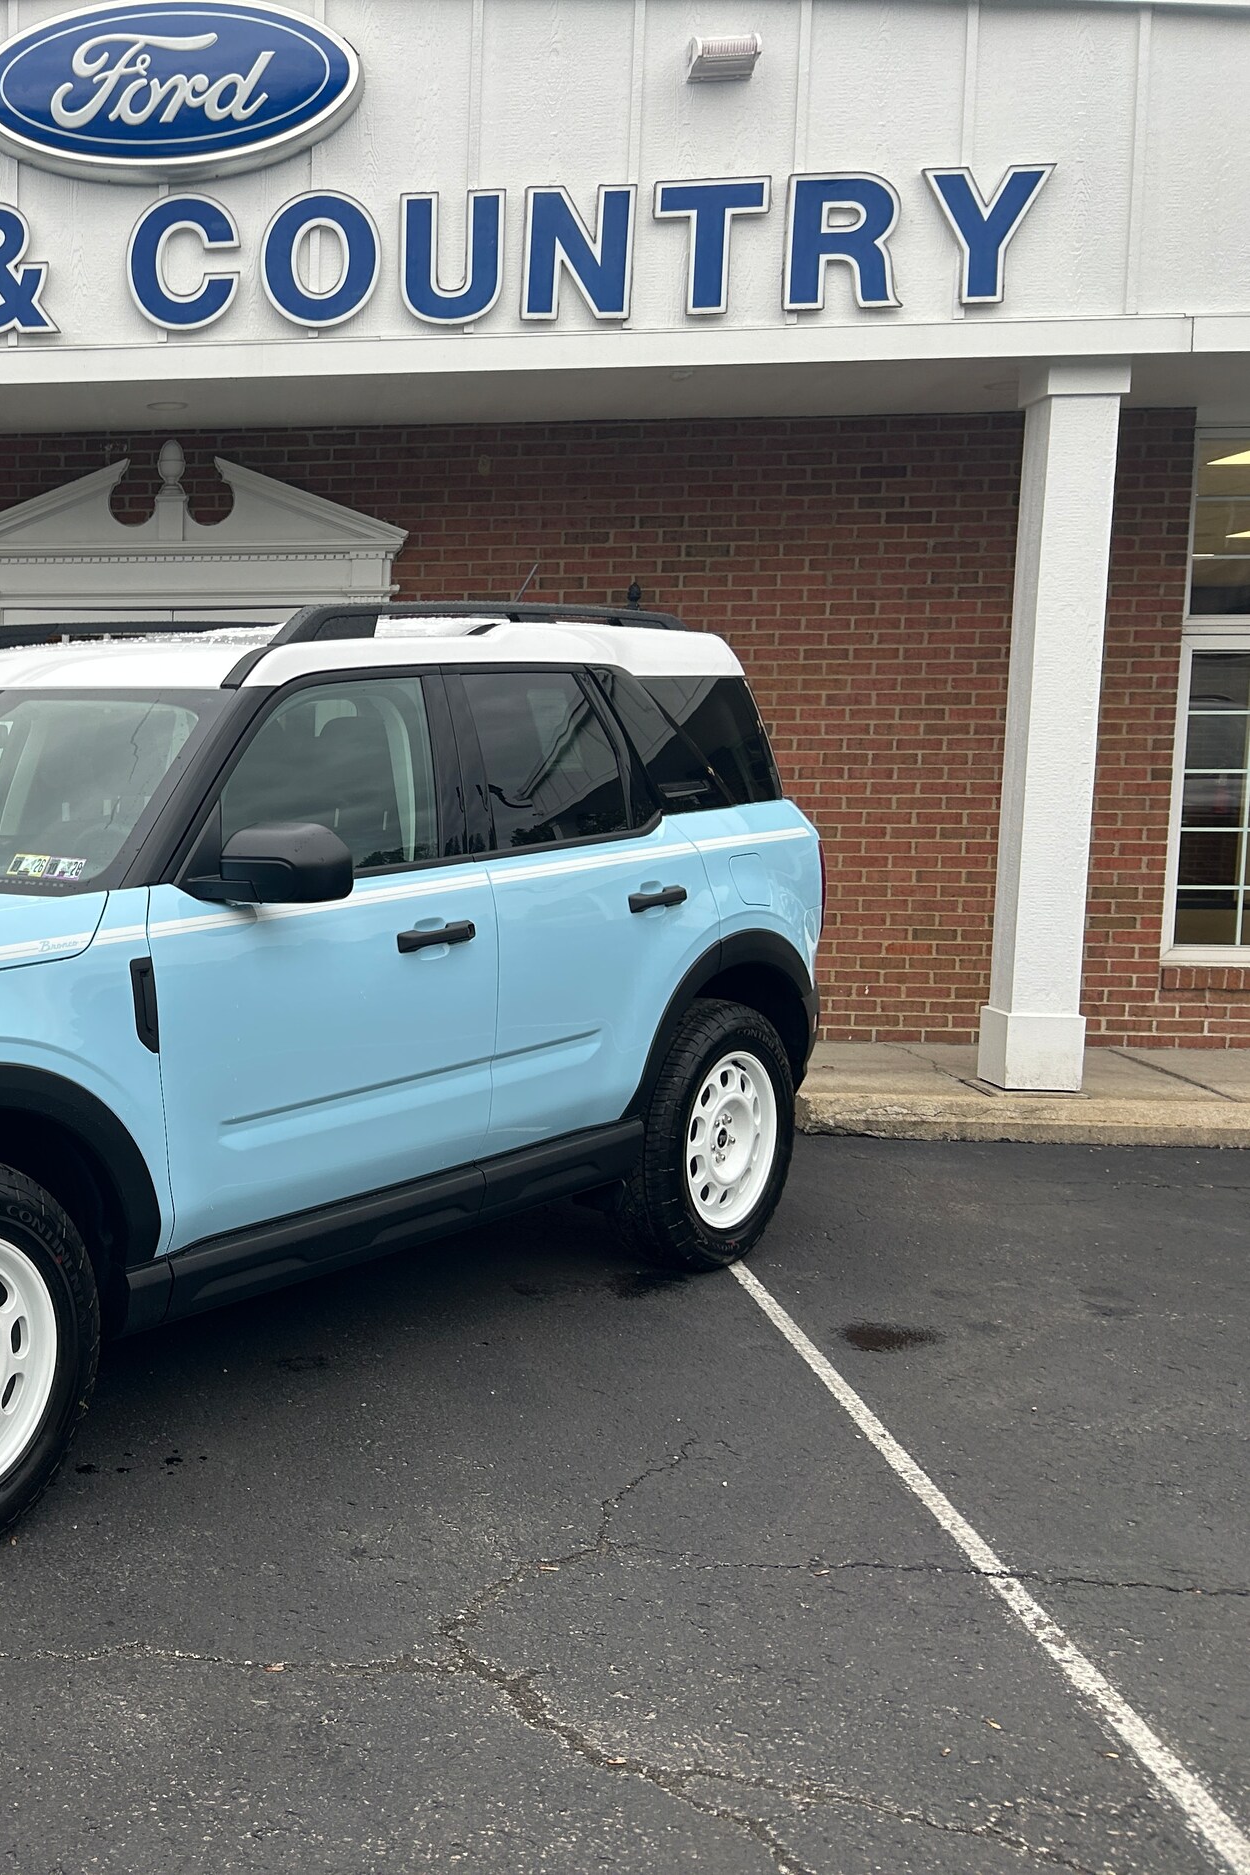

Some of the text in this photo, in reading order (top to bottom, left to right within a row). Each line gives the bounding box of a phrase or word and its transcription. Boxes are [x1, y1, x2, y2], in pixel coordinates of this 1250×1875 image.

[51, 33, 275, 129] Ford
[126, 163, 1056, 331] COUNTRY
[38, 940, 79, 953] Bronco
